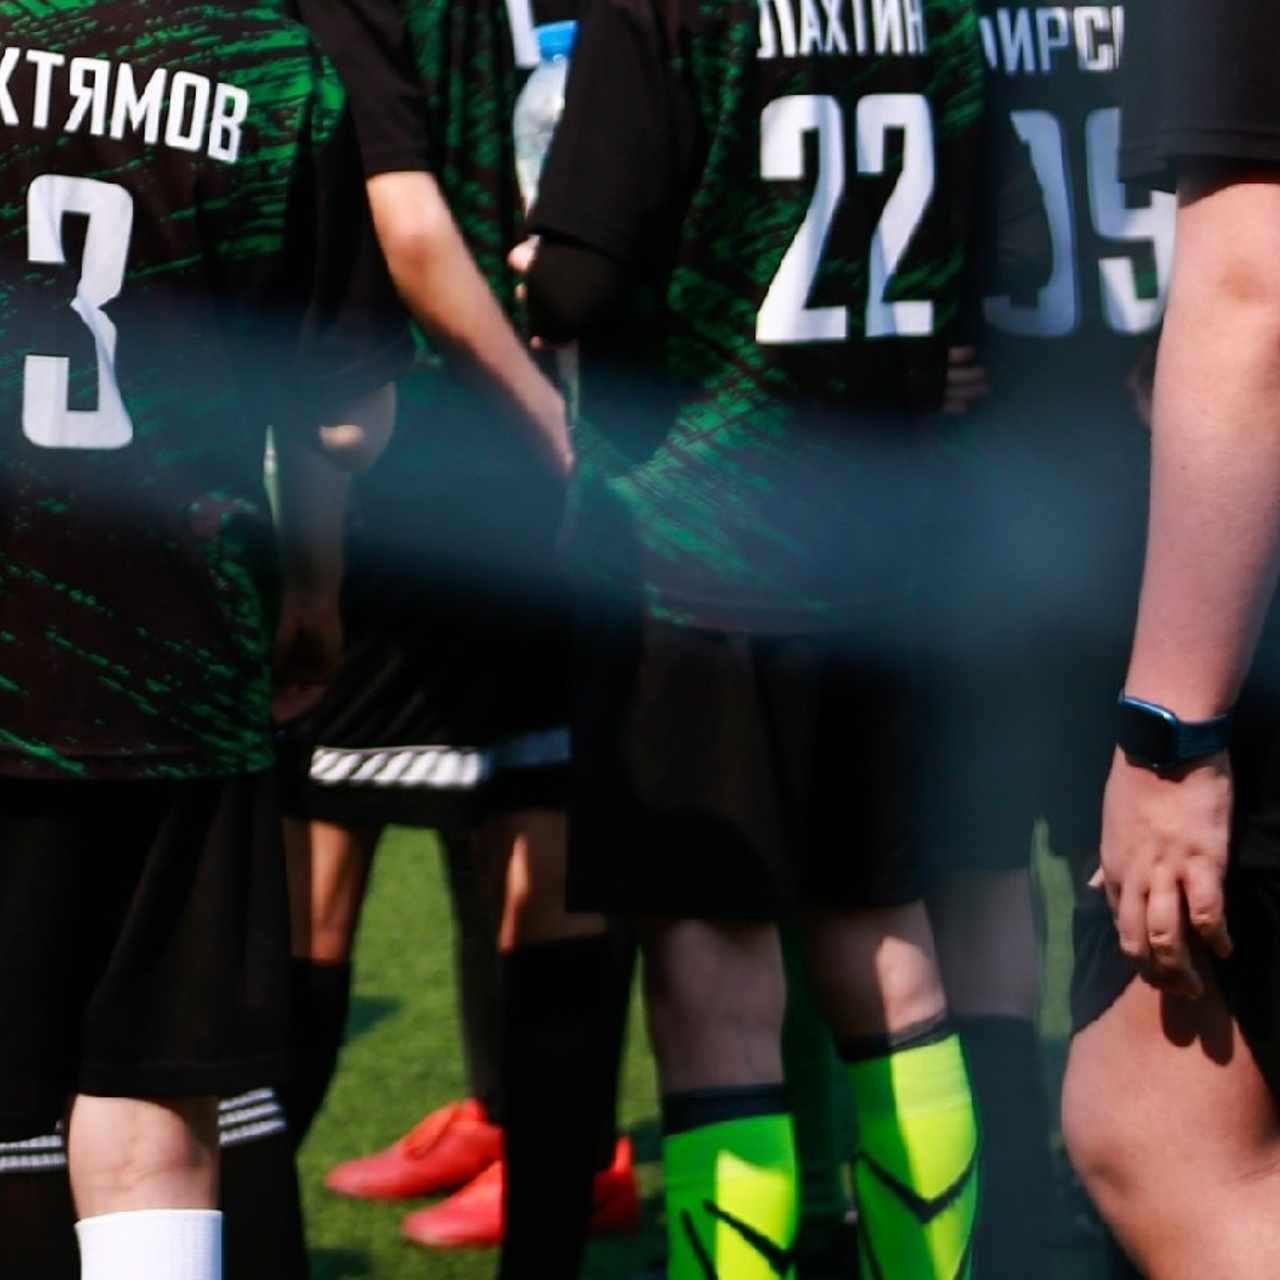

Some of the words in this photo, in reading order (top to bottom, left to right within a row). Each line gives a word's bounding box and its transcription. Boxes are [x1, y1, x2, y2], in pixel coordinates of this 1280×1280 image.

[979, 5, 1124, 74] ИРС
[21, 173, 134, 450] 3
[756, 93, 935, 344] 22
